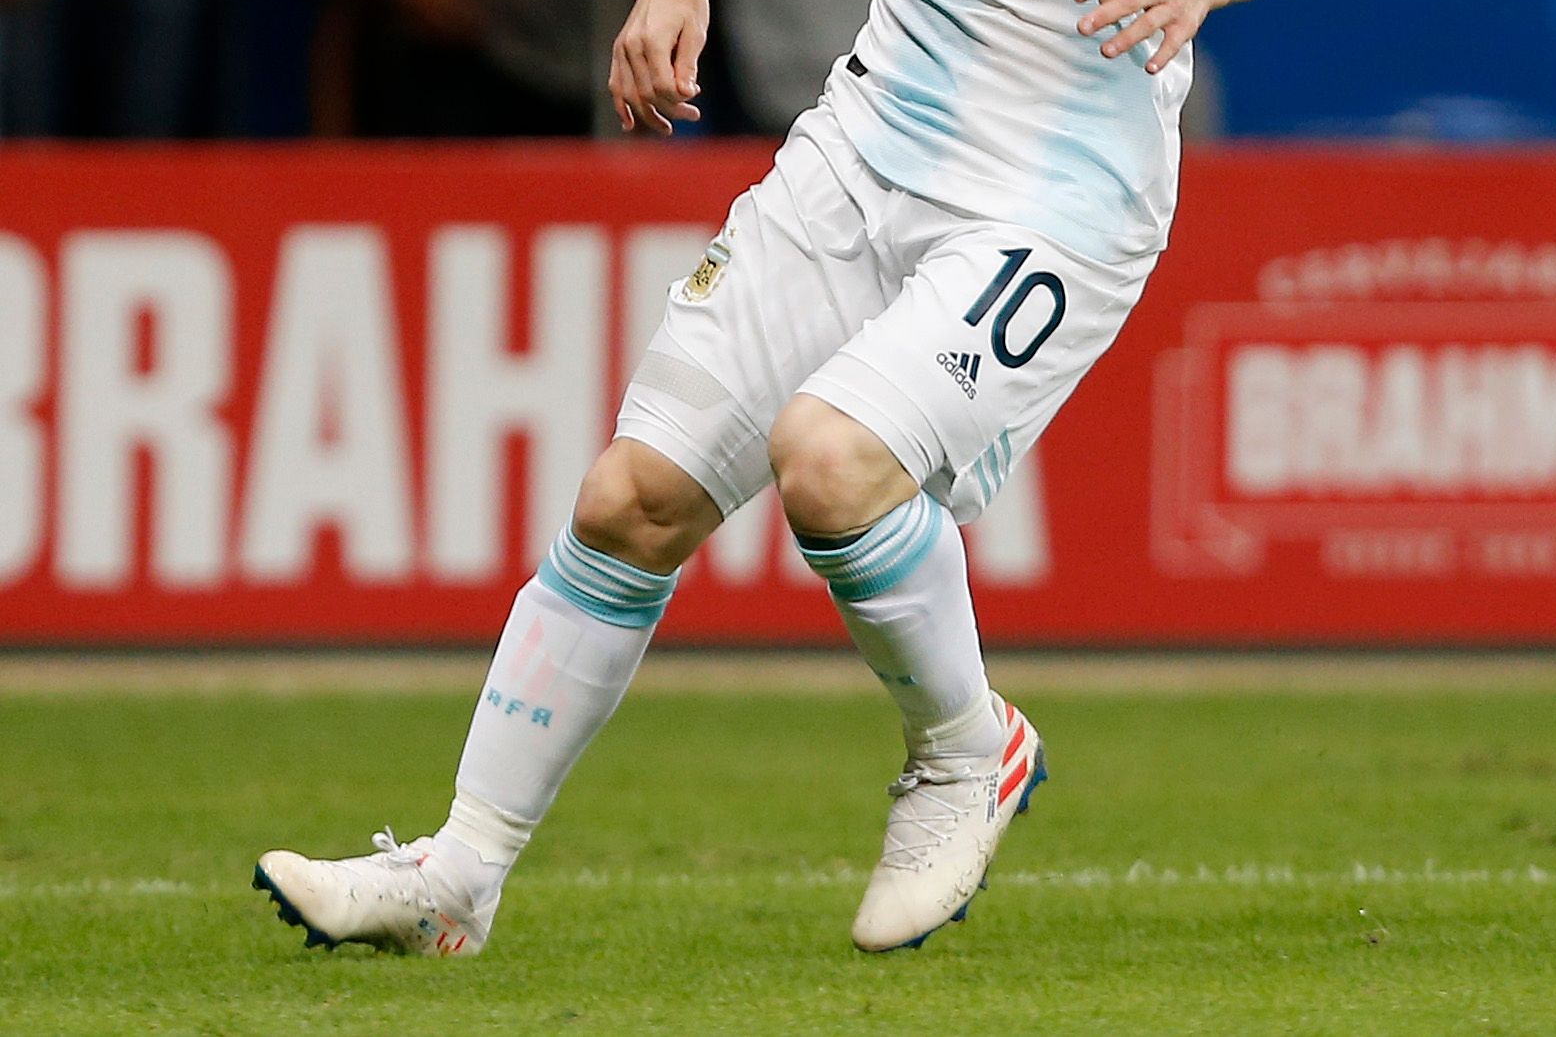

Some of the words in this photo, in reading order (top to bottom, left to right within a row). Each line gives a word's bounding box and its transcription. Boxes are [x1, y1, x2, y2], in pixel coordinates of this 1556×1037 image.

[963, 248, 1066, 369] 10
[0, 223, 1052, 596] RAH
[936, 352, 977, 400] adidas
